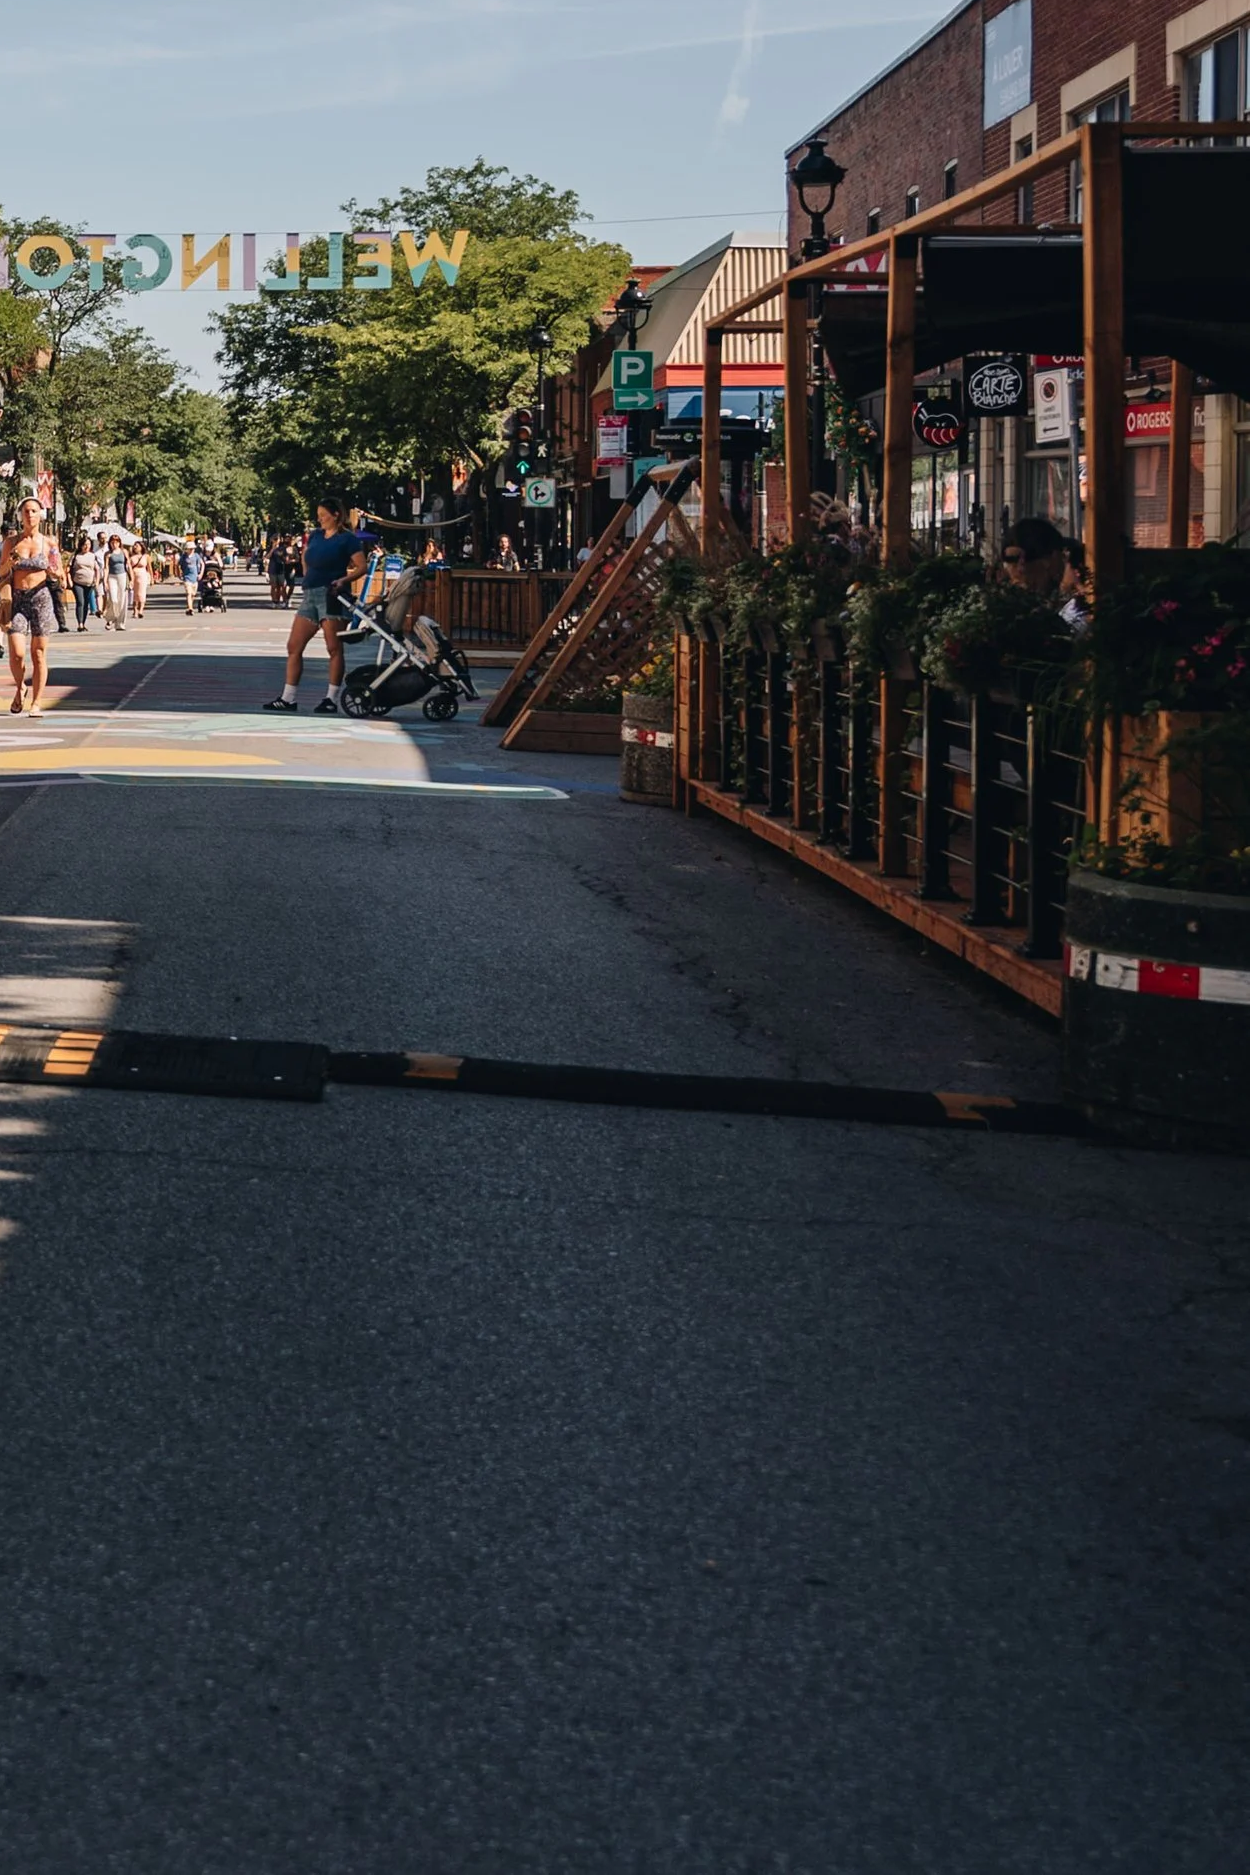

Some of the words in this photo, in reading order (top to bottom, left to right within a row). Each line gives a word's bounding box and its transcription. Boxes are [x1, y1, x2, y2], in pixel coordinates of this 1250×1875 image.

[620, 356, 646, 385] P
[971, 374, 1018, 395] CARTE
[1136, 411, 1172, 430] ROGERS
